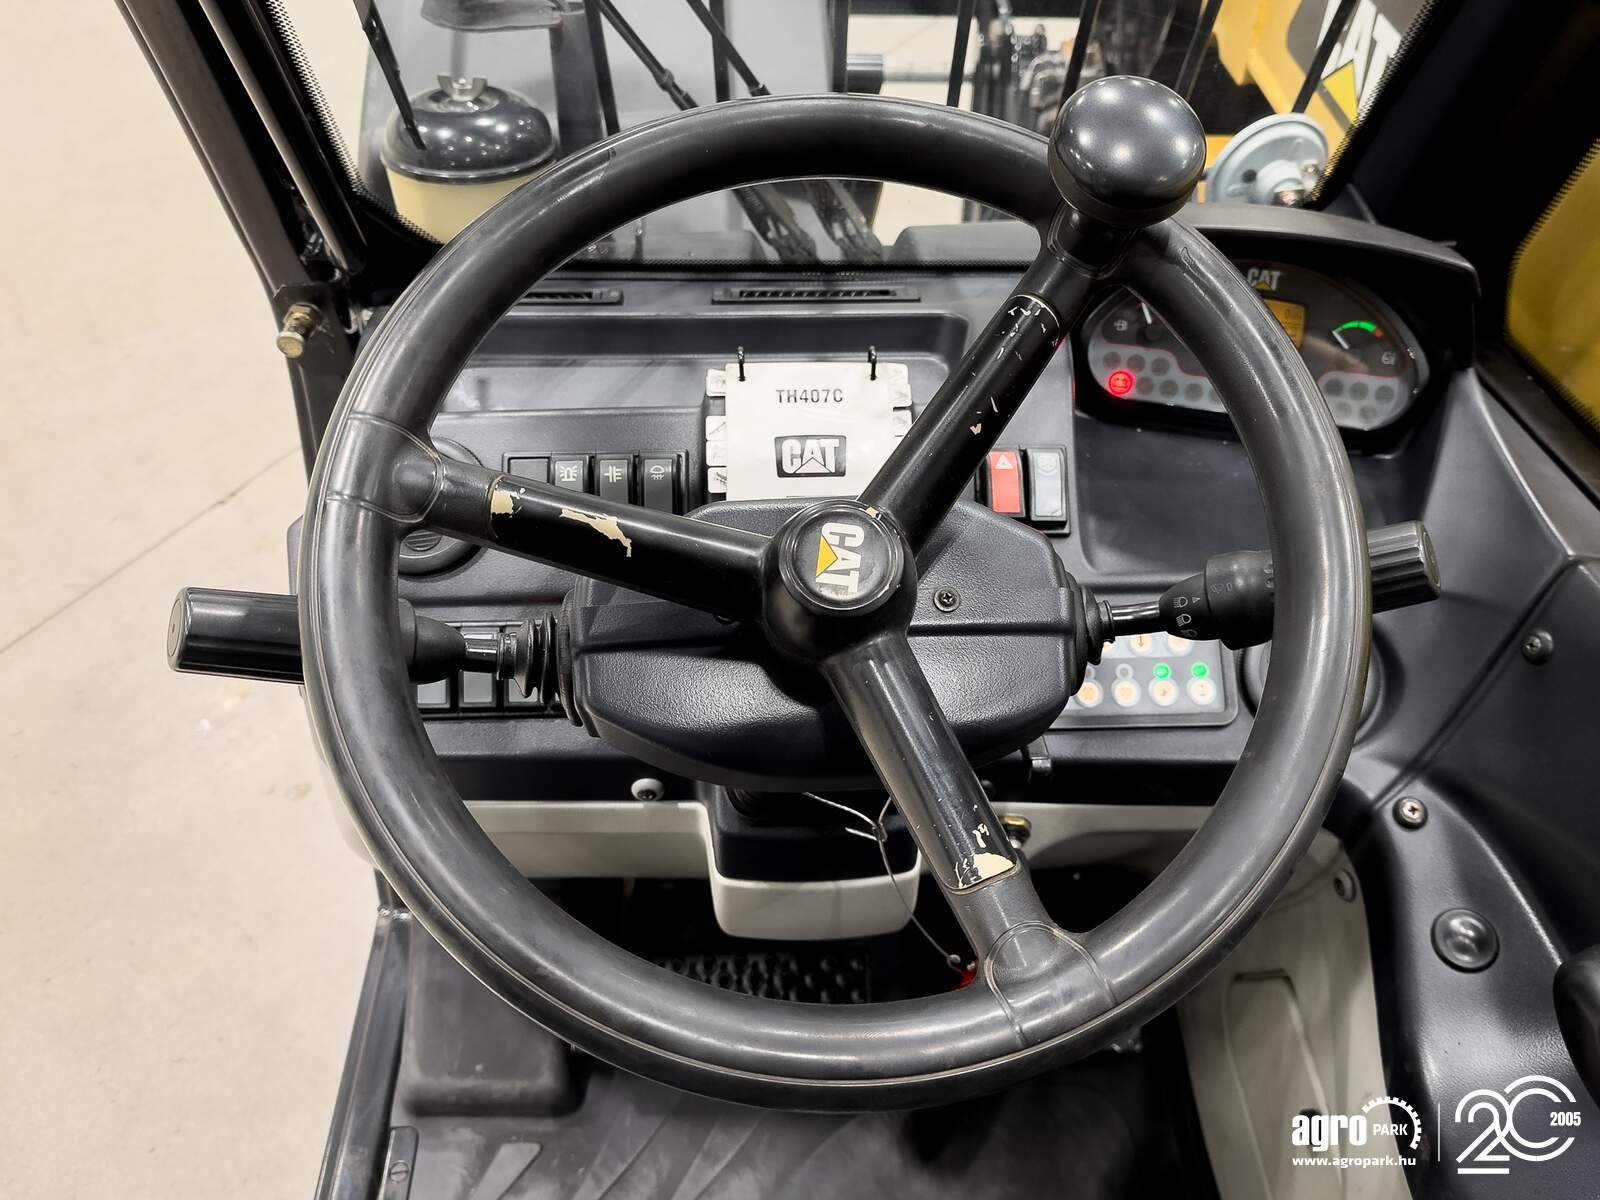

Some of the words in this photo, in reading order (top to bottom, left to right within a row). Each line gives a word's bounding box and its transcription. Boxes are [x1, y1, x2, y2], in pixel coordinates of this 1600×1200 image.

[1247, 268, 1283, 291] CAT
[775, 388, 844, 404] TH407C
[781, 437, 841, 475] CAT
[815, 522, 866, 594] CAT
